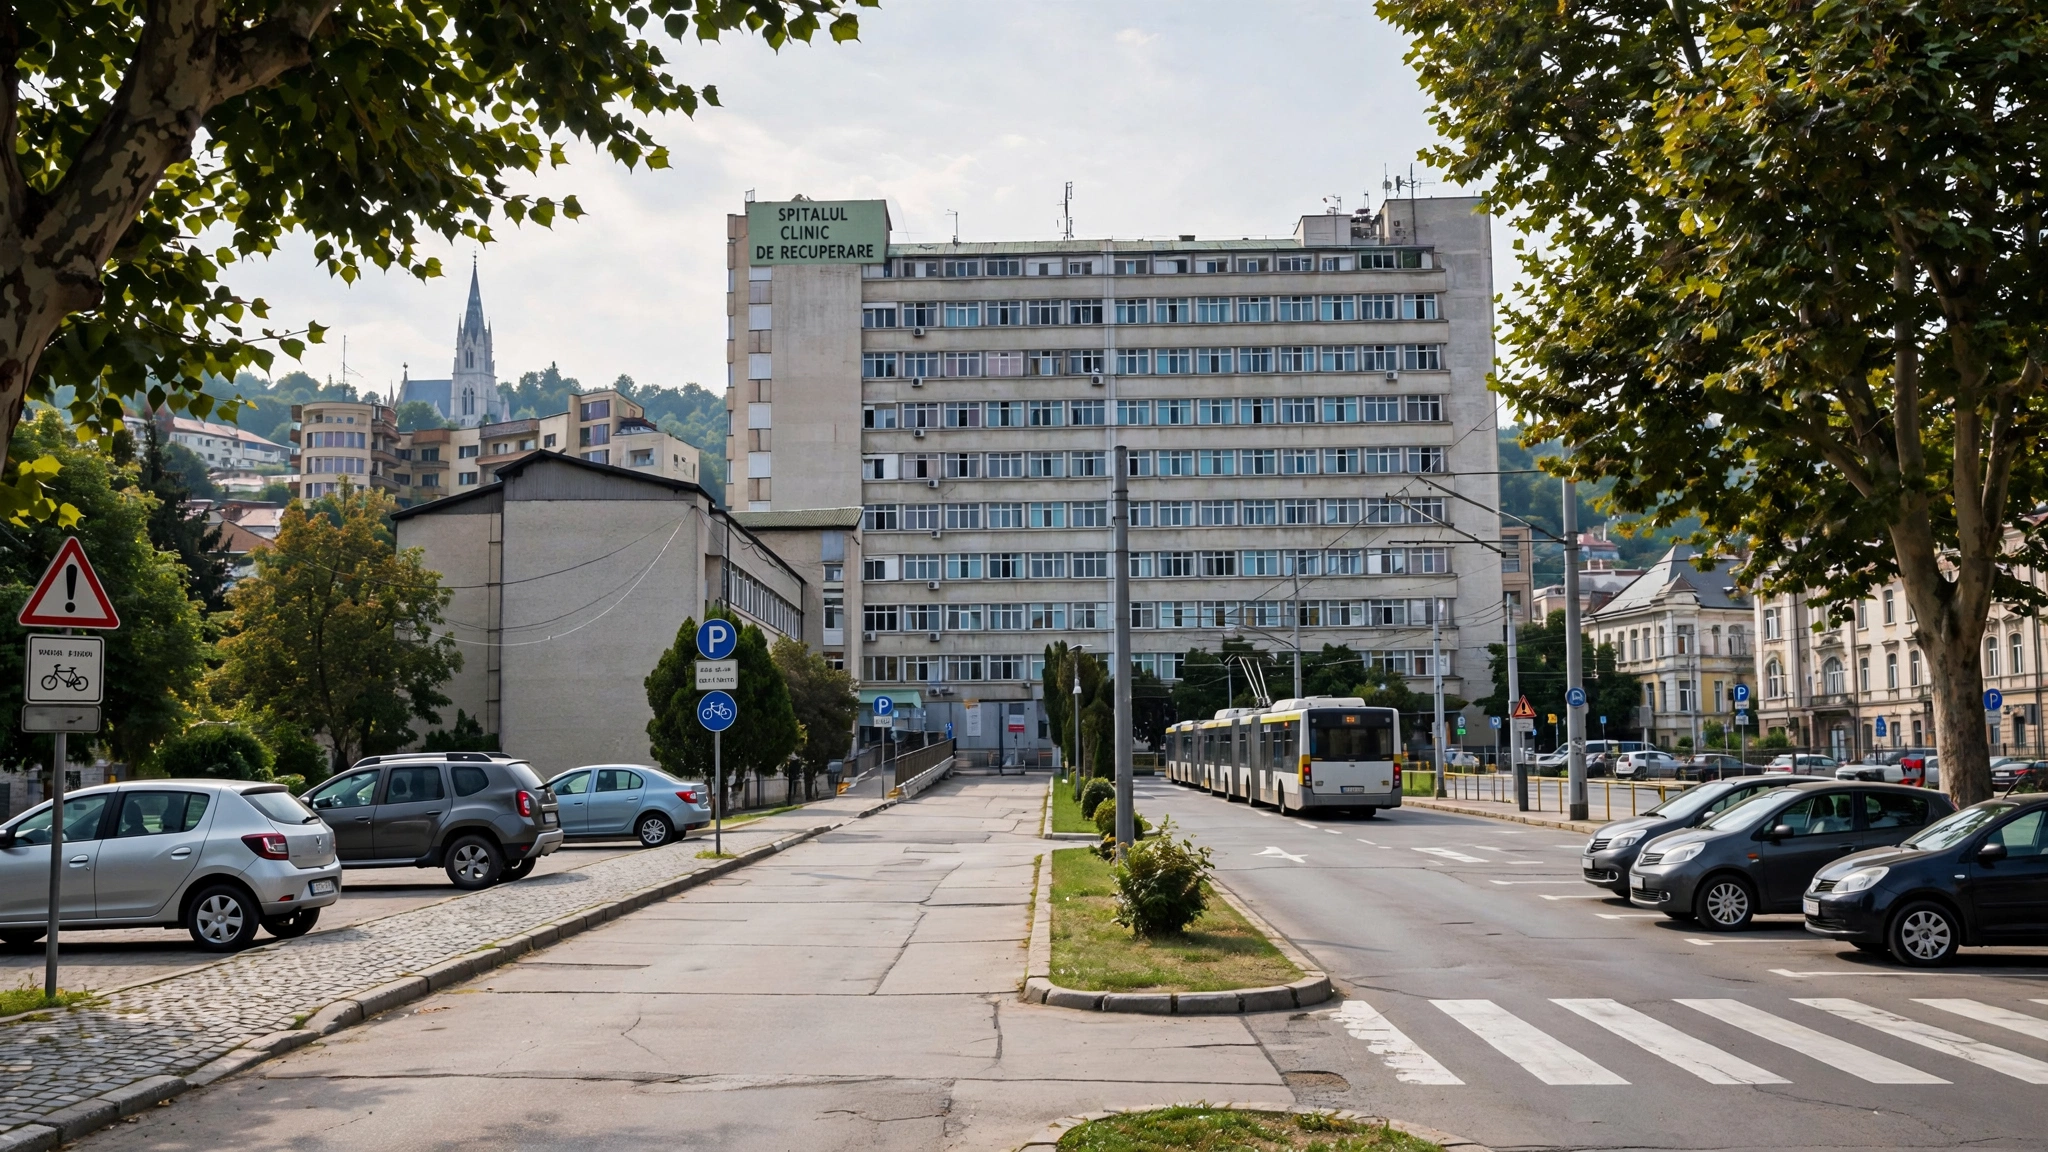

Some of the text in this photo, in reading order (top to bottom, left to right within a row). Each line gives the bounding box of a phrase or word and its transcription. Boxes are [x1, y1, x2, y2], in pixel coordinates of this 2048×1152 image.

[778, 207, 848, 221] SPITALUL
[780, 225, 829, 240] CLINIC
[756, 244, 874, 259] DE RECUPERARE
[708, 625, 727, 653] P
[1737, 686, 1746, 700] P
[879, 698, 889, 714] P
[1989, 693, 1998, 709] P
